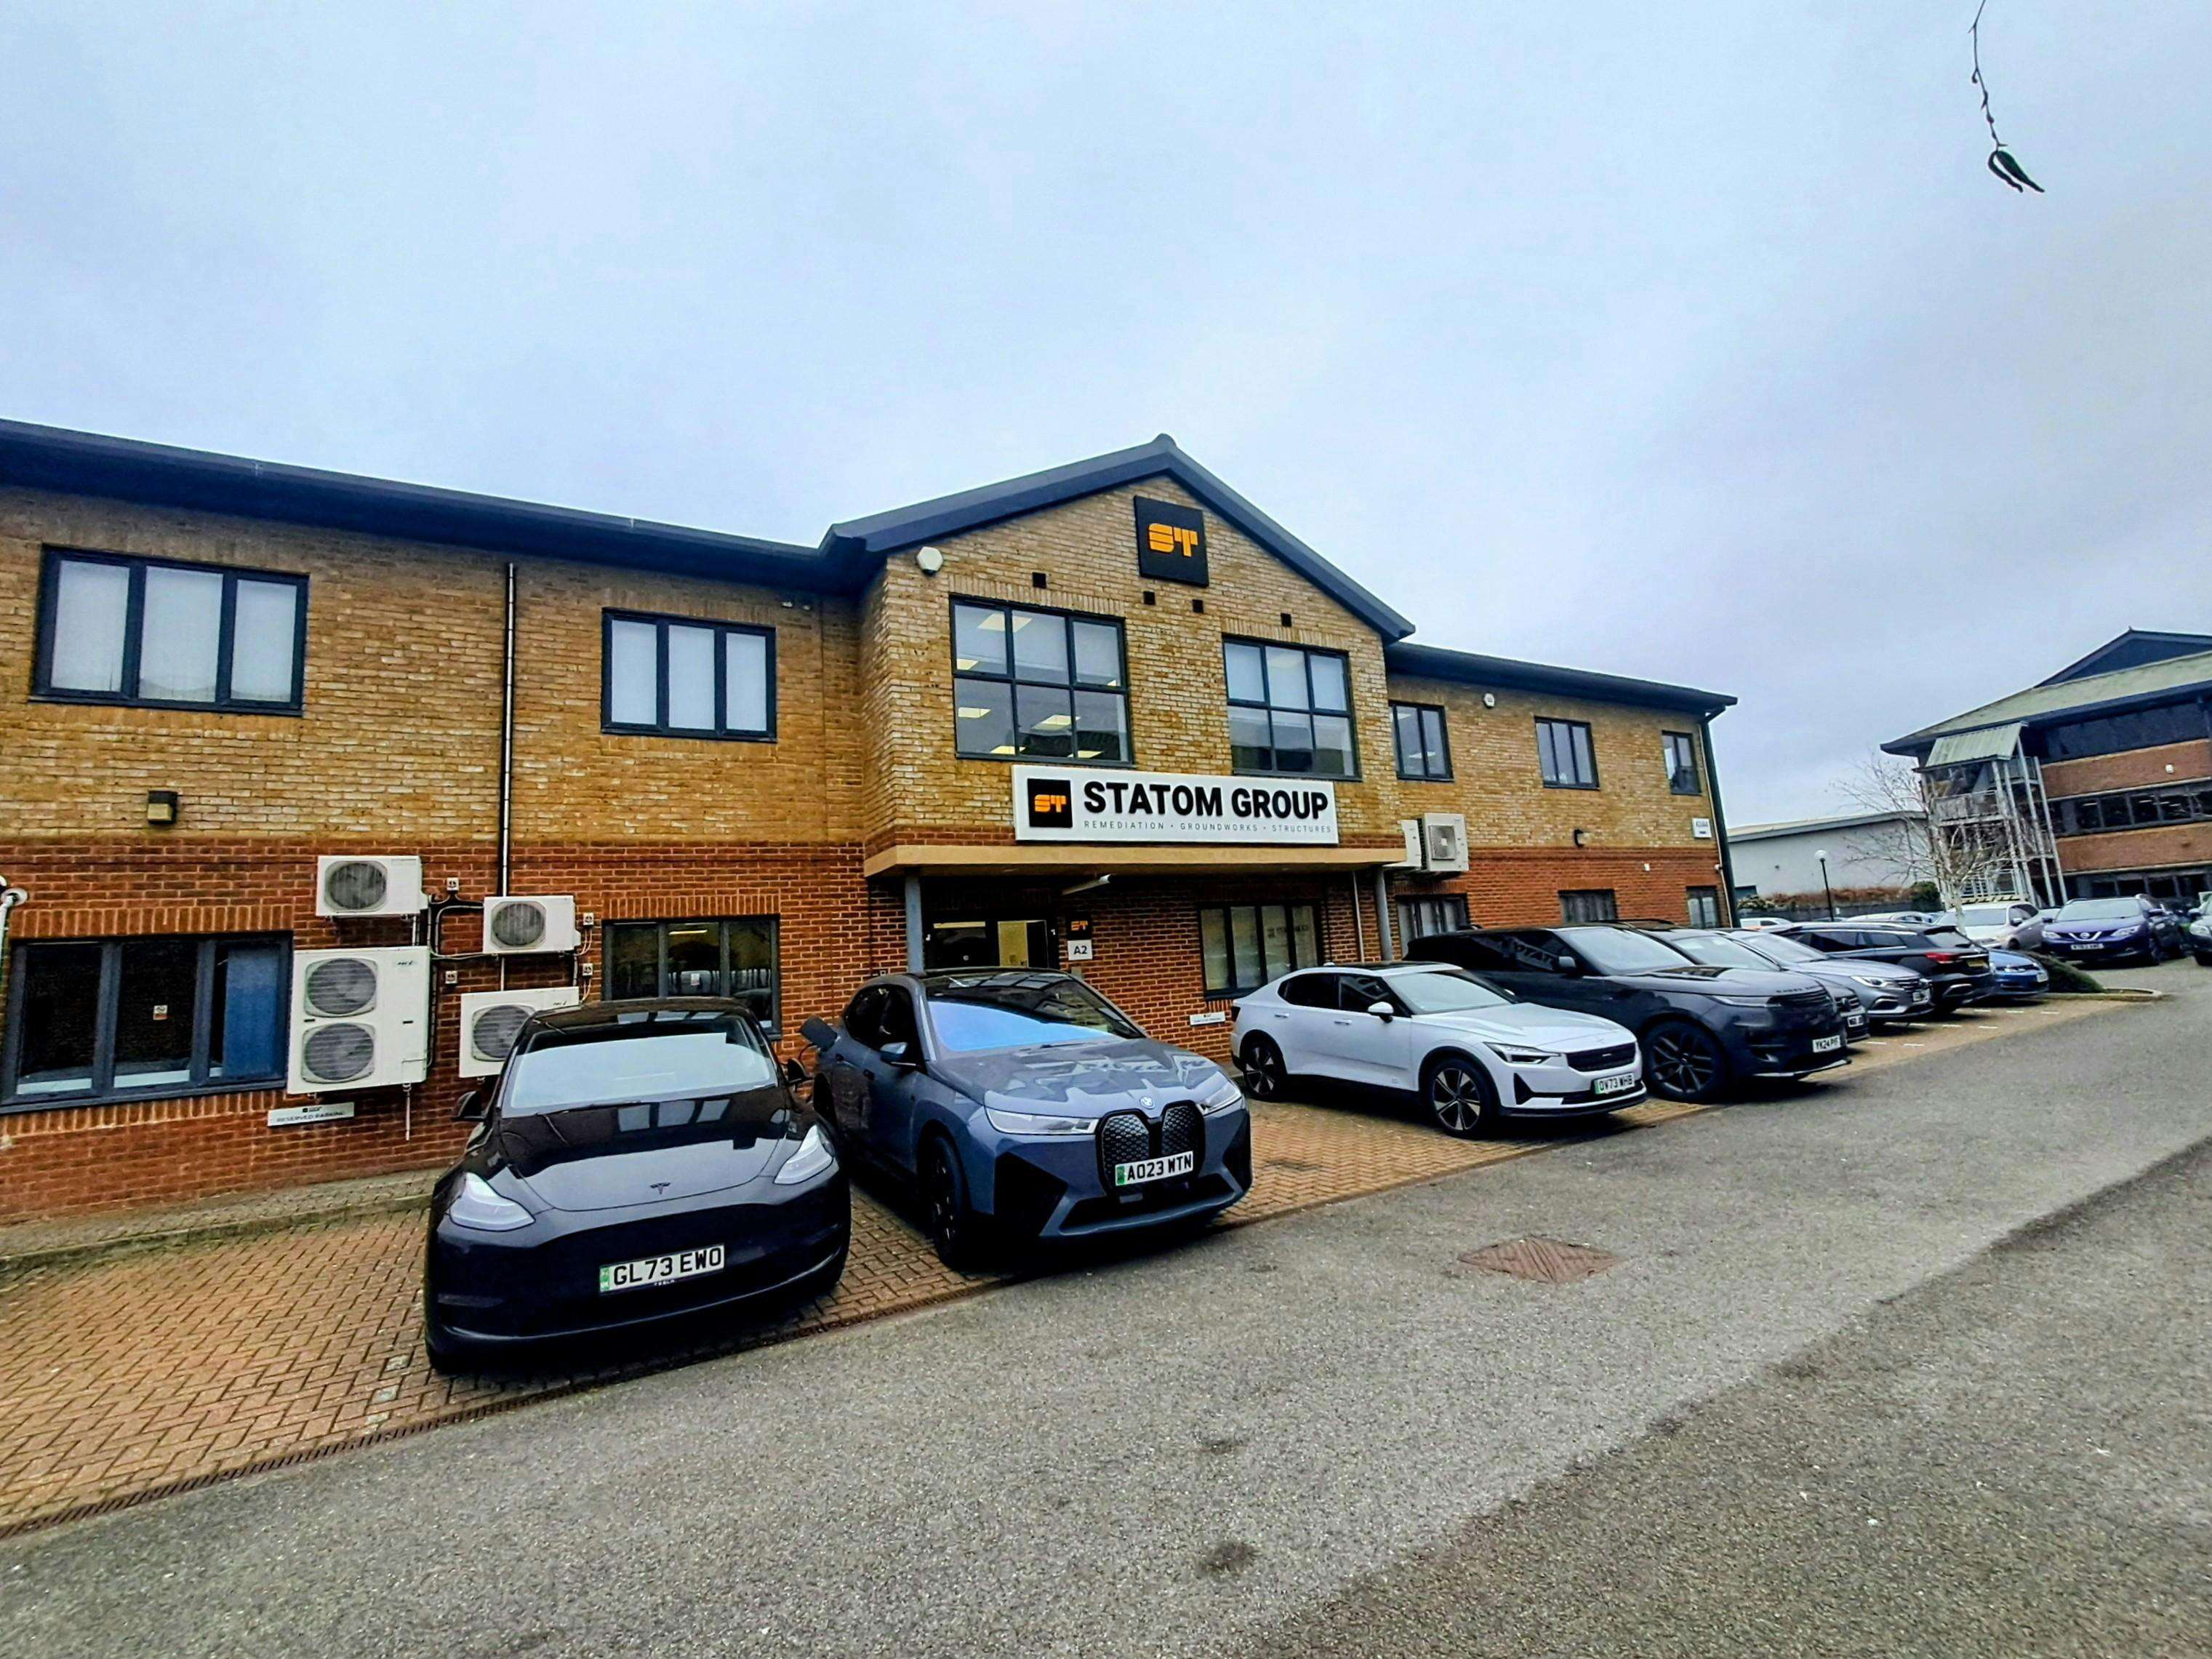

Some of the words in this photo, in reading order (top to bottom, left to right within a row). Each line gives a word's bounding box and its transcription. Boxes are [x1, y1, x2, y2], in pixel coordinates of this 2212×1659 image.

[1083, 781, 1223, 817] STATOM
[1231, 788, 1329, 820] GROUP
[1084, 820, 1163, 829] REMEDIATION
[1180, 823, 1258, 832] GROUNDWORKS
[1273, 825, 1331, 833] STRUCTURES
[1073, 946, 1088, 954] A2
[1600, 1077, 1618, 1091] OV73
[1127, 1160, 1163, 1180] AO23
[1168, 1154, 1192, 1174] WTN
[613, 1257, 673, 1285] GL73
[680, 1247, 721, 1274] EWO
